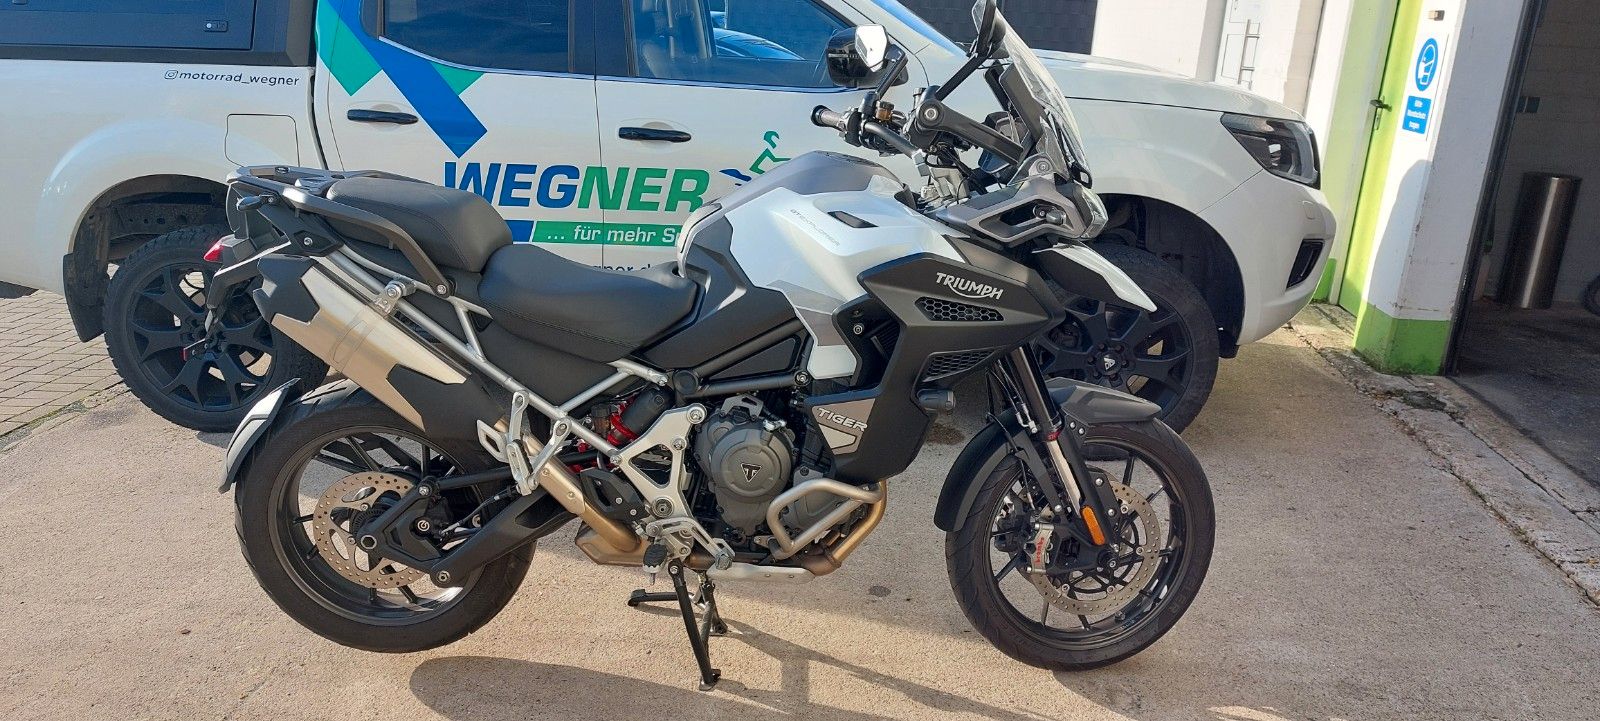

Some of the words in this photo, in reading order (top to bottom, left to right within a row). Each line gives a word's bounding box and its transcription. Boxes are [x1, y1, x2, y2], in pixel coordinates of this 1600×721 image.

[179, 73, 300, 86] motorrad_wegner
[444, 162, 710, 212] WEGNER
[574, 225, 601, 241] für
[607, 227, 656, 242] mehr
[936, 272, 1004, 300] TRIUMPH
[816, 407, 868, 432] TIGER
